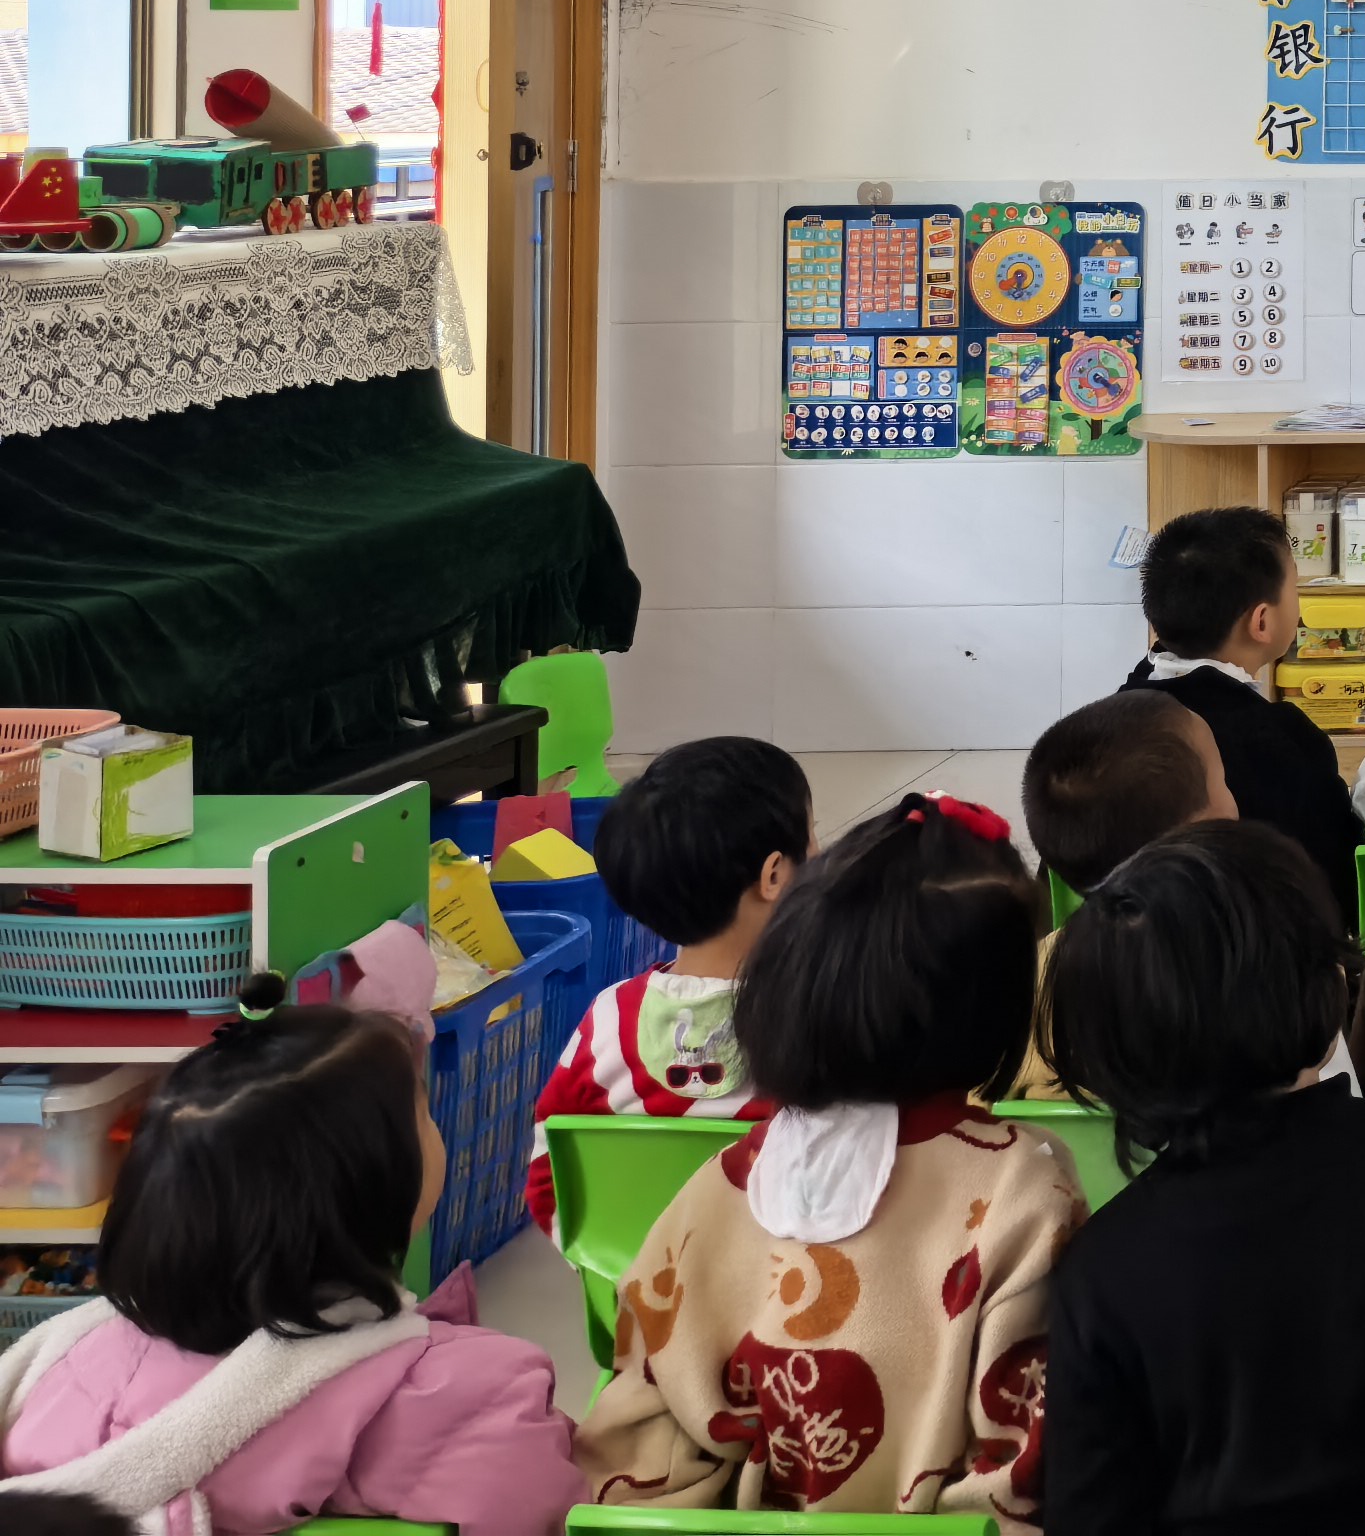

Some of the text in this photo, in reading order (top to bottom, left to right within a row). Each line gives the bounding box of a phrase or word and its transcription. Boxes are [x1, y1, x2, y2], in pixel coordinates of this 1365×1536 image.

[1179, 194, 1286, 208] 值日小当家
[1017, 234, 1028, 245] 12
[985, 253, 996, 262] 10
[1050, 252, 1057, 262] 2
[1236, 261, 1245, 273] 1
[1265, 261, 1274, 273] 2
[1055, 271, 1062, 281] 3
[1049, 290, 1056, 299] 4
[1236, 288, 1246, 300] 3
[1268, 285, 1277, 297] 4
[1016, 309, 1023, 318] 6
[1036, 304, 1044, 314] 5
[1238, 310, 1247, 322] 5
[1267, 309, 1276, 321] 6
[1239, 335, 1247, 346] 7
[1268, 331, 1277, 343] 8
[1239, 359, 1247, 370] 9
[1264, 358, 1276, 368] 10
[1350, 543, 1358, 554] 7
